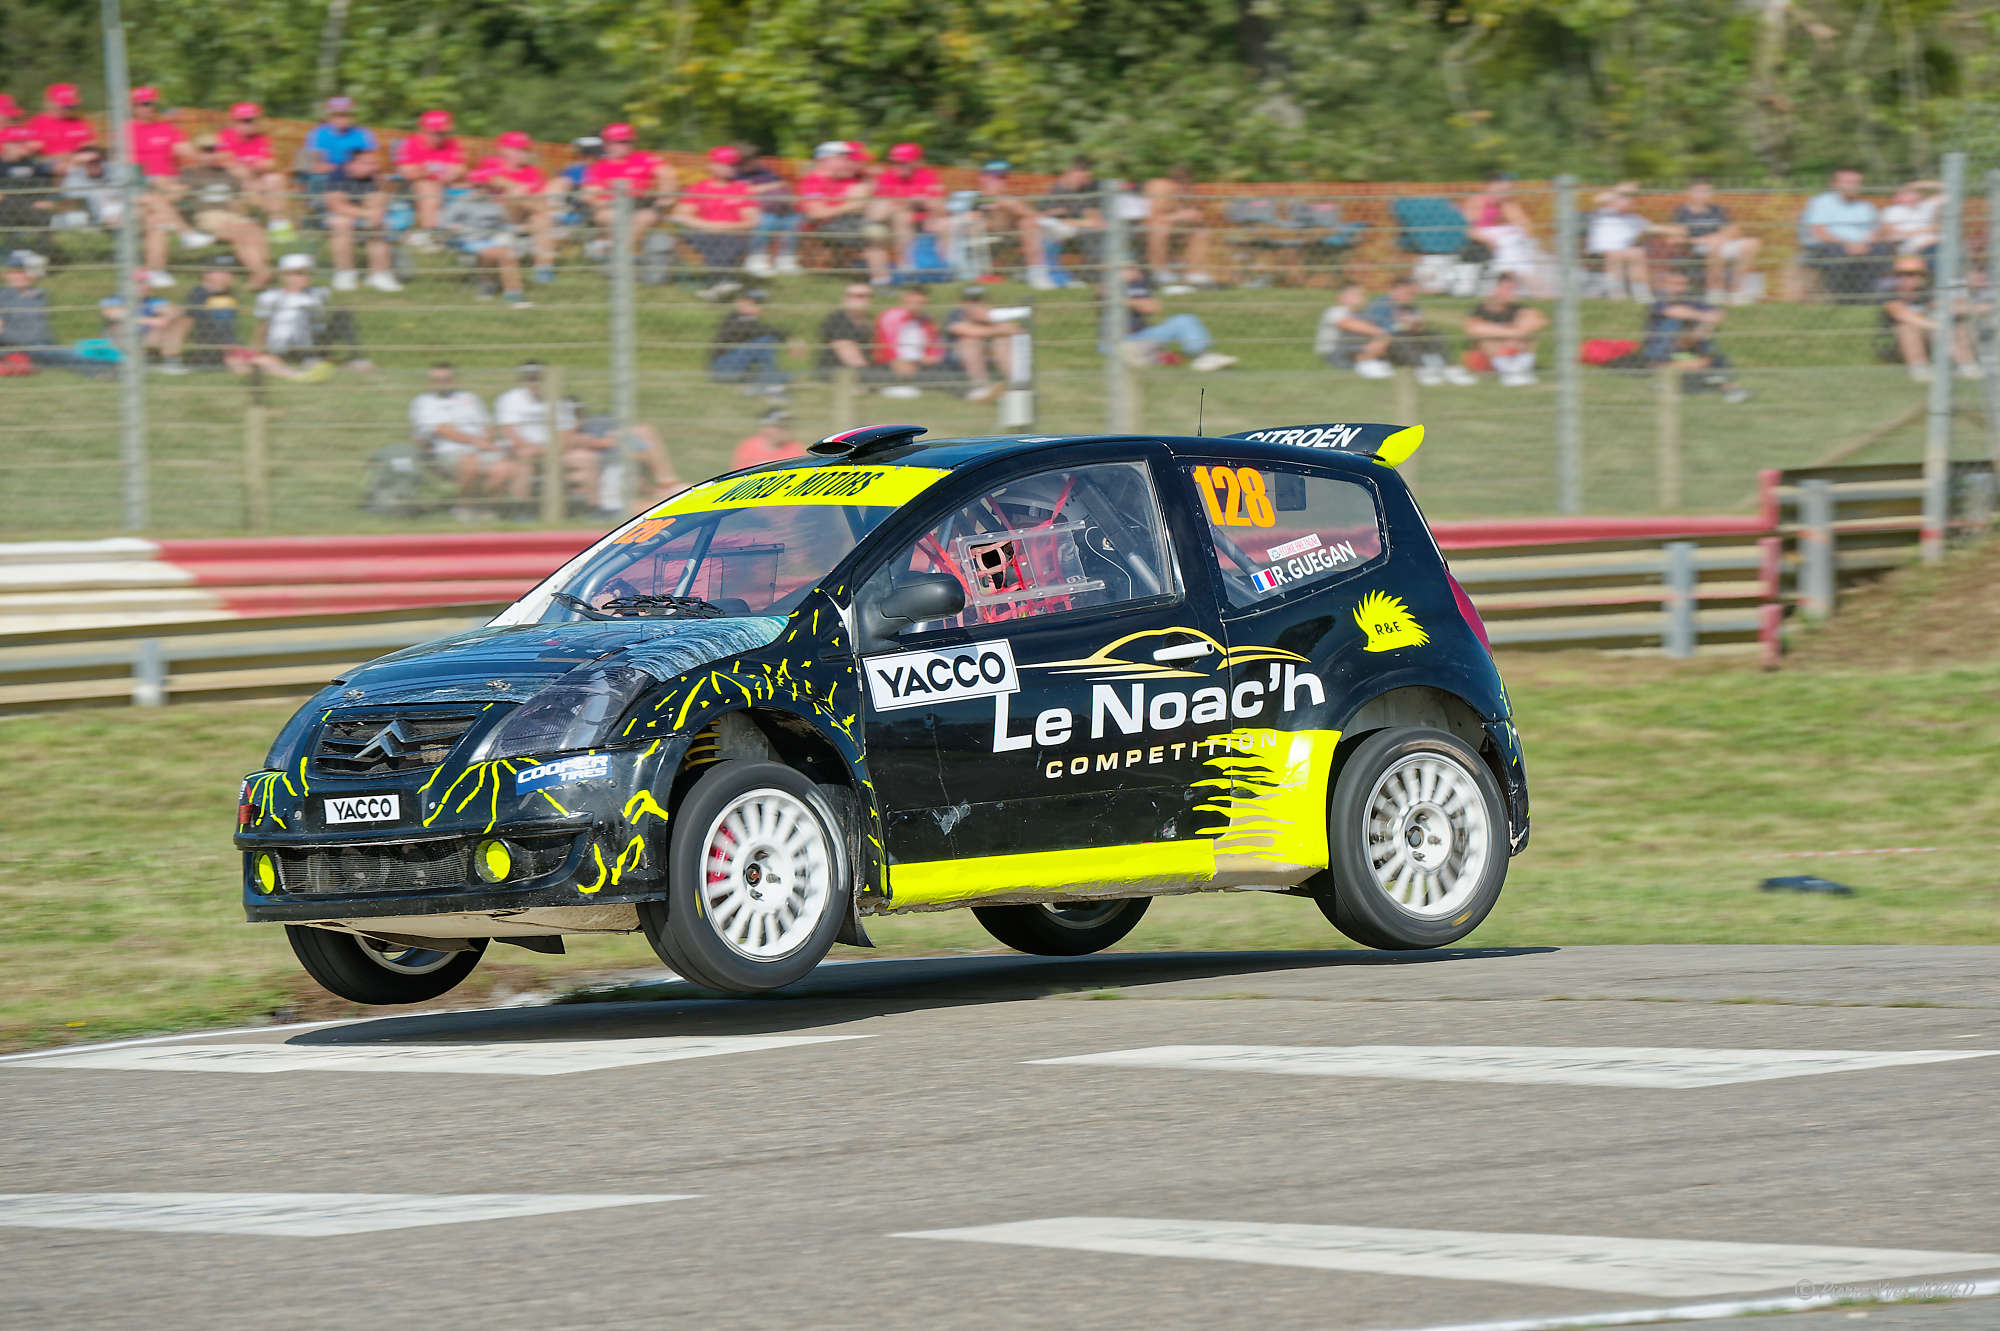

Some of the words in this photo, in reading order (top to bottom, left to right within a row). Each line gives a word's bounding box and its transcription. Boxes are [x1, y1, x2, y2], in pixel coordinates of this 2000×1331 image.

[784, 471, 885, 497] MOTORS
[1193, 465, 1276, 528] 128
[1274, 541, 1357, 586] R.GUEGAN
[877, 651, 1007, 698] YACCO
[992, 692, 1073, 753] Le
[1091, 663, 1327, 739] Noac'h
[1045, 730, 1277, 779] COMPETITION
[332, 799, 392, 819] YACCO
